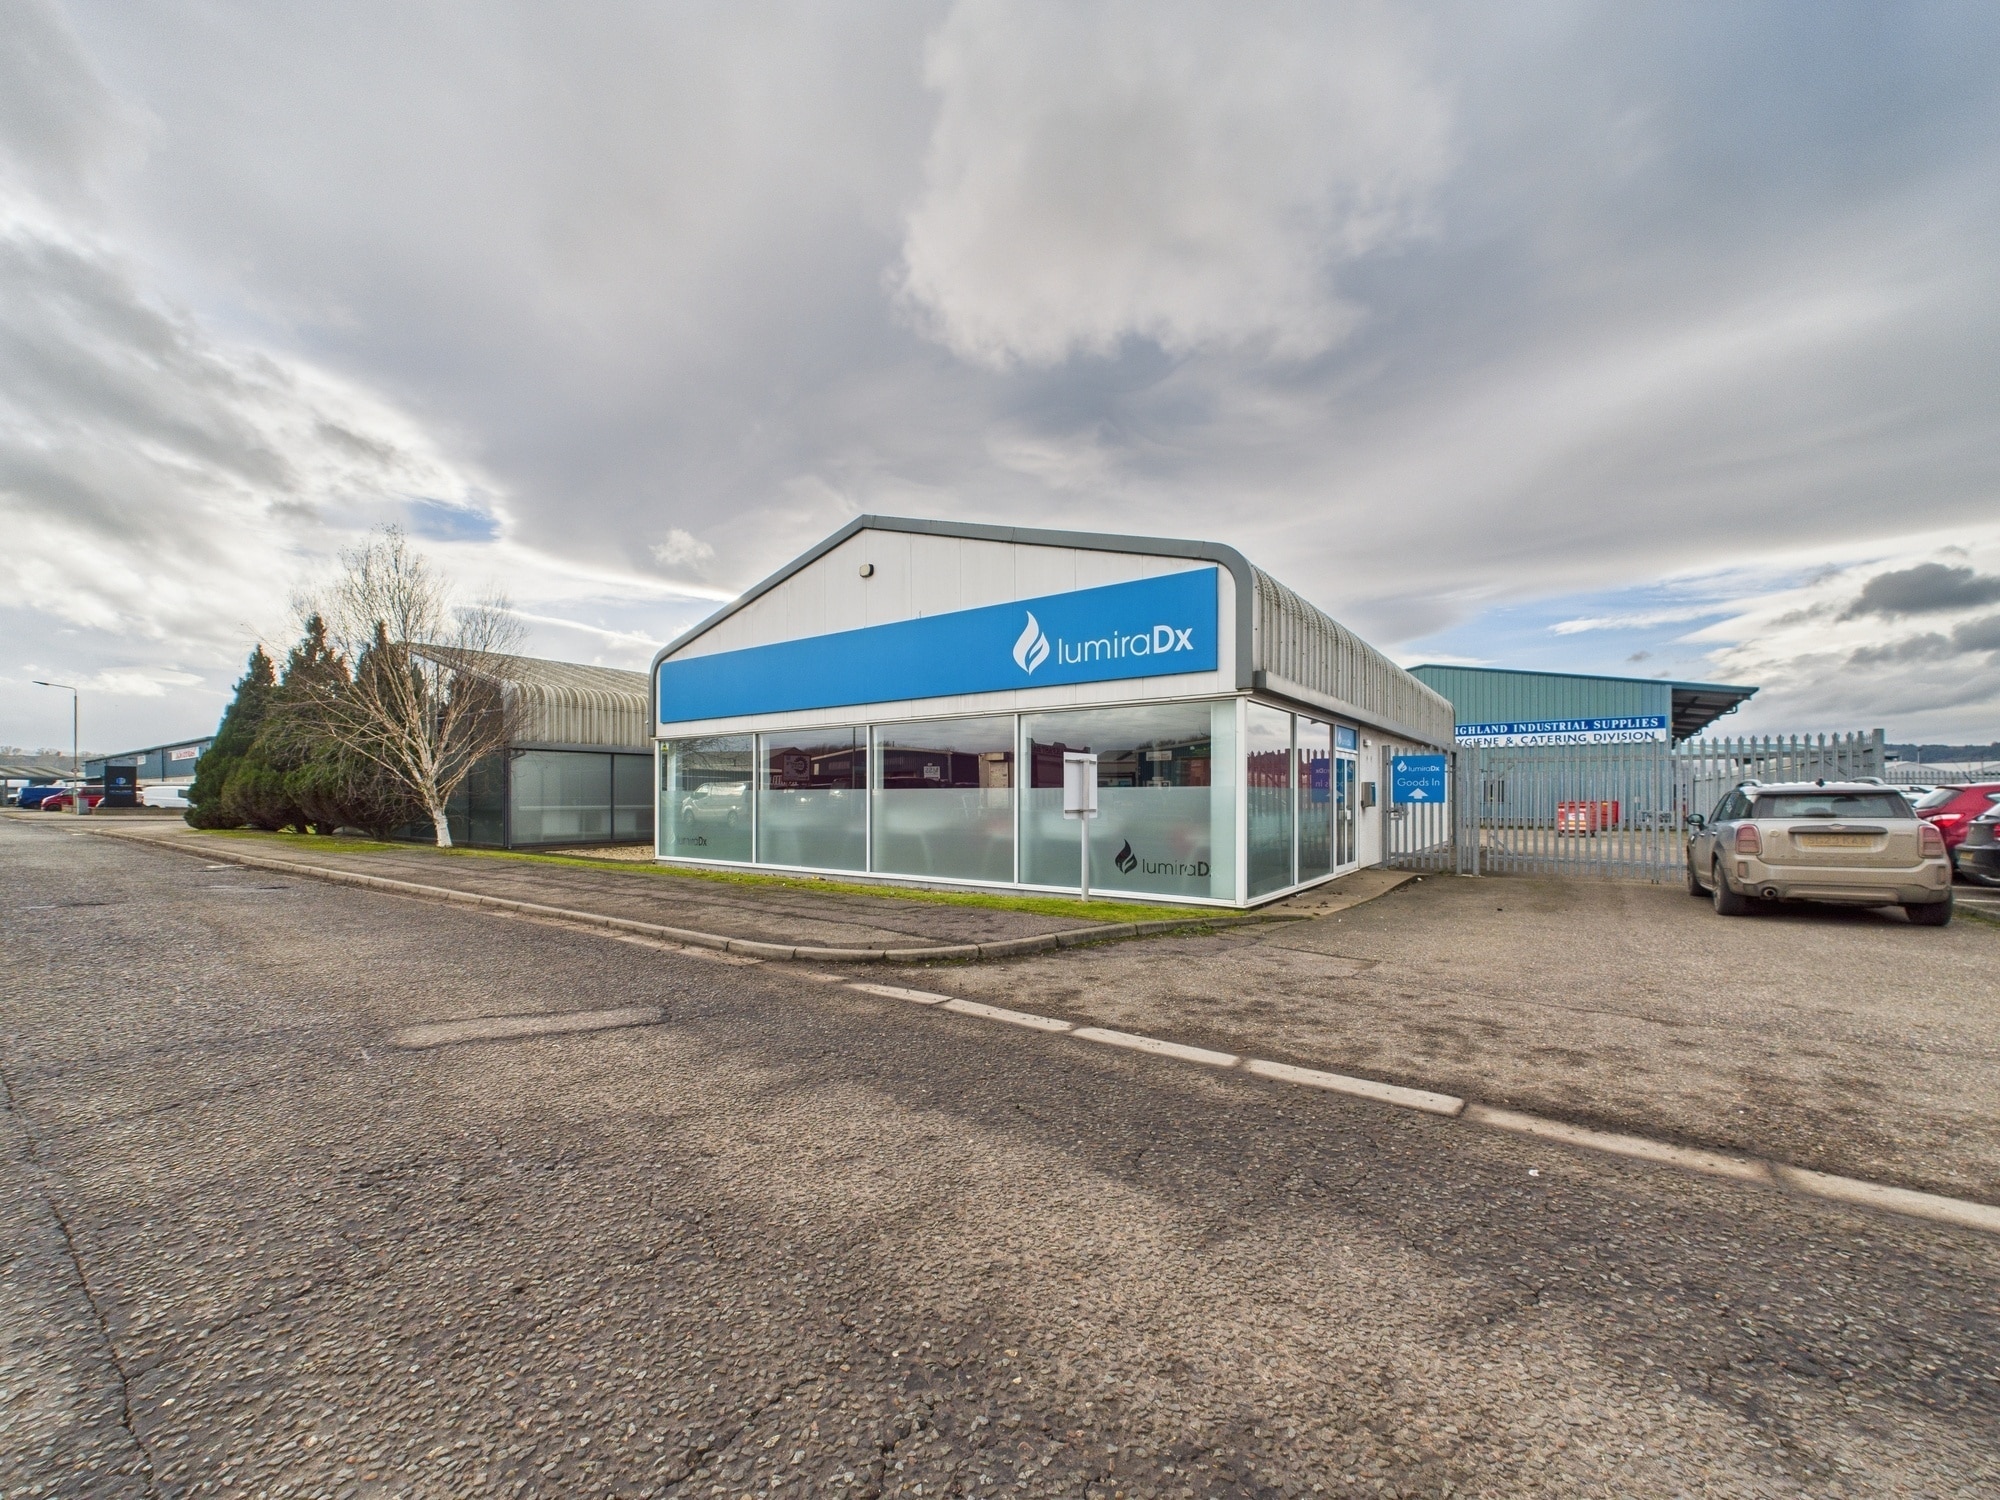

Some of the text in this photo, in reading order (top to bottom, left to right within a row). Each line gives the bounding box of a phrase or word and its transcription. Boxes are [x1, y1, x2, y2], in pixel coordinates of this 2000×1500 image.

[1058, 624, 1194, 665] lumiraDx
[1455, 717, 1659, 735] IGHLAND INDUSTRIAL SUPPLIES
[1457, 731, 1655, 746] YGIENE & CATERING DIVISION
[1397, 777, 1440, 787] Goods In
[1142, 858, 1212, 877] lumiraD
